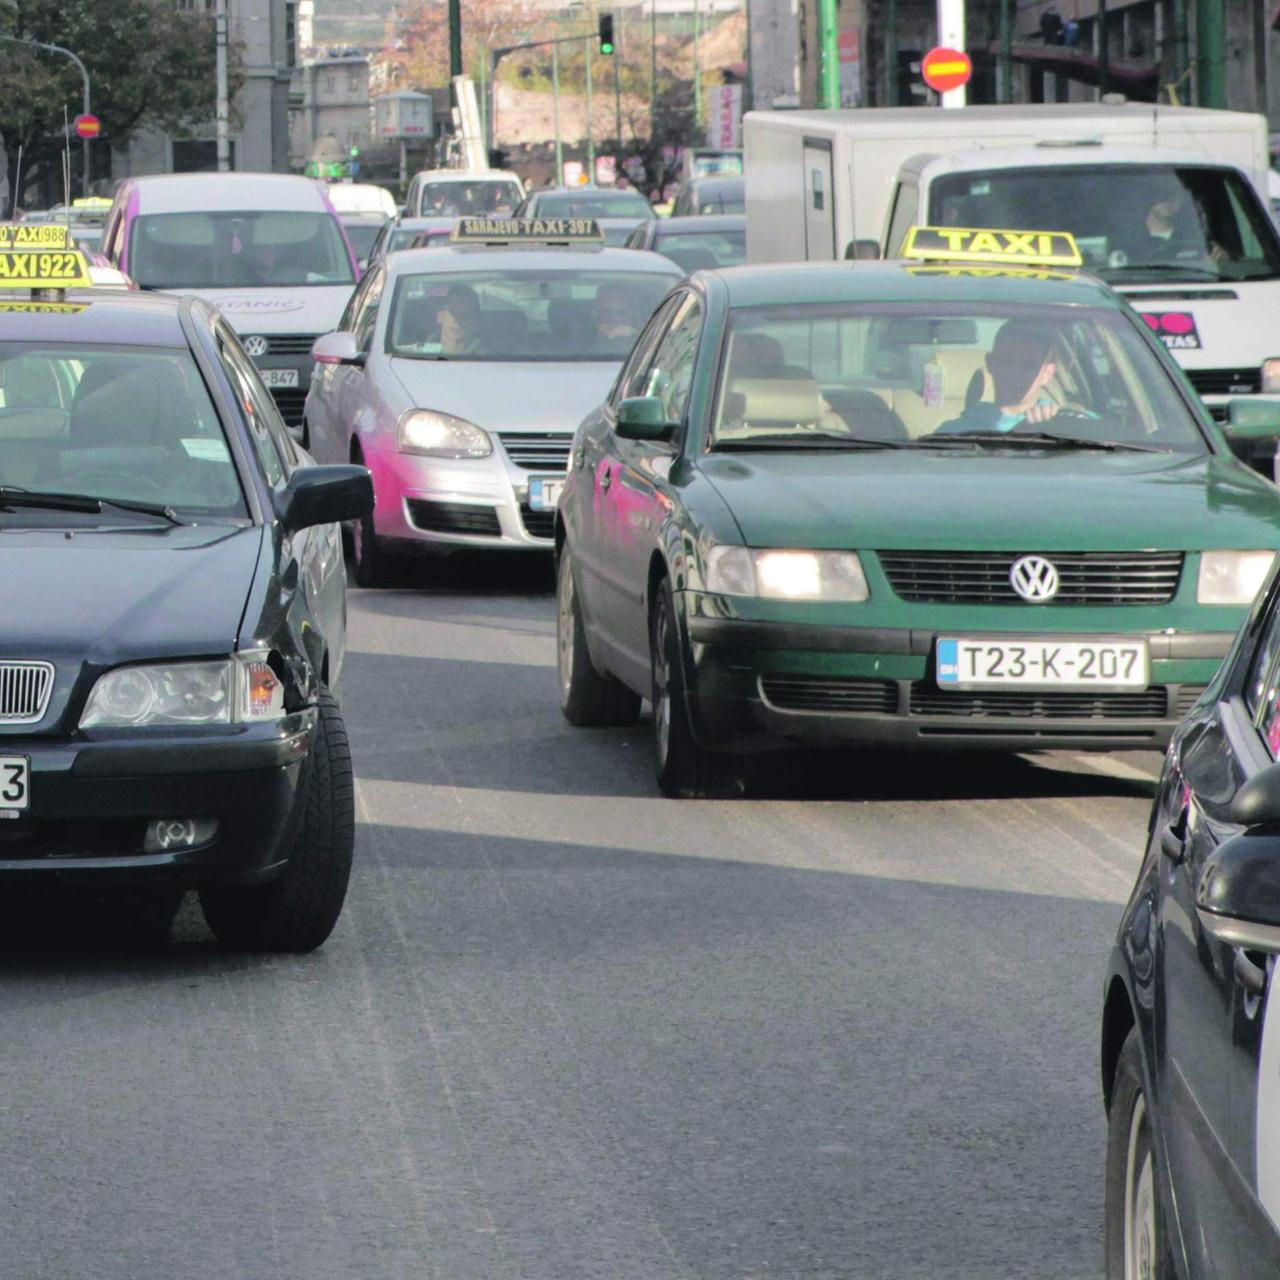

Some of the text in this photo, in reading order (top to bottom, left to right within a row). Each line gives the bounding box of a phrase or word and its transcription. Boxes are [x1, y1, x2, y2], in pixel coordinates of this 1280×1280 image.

[937, 230, 1053, 258] TAXI
[40, 254, 76, 278] 922
[963, 646, 1139, 680] T23-K-207
